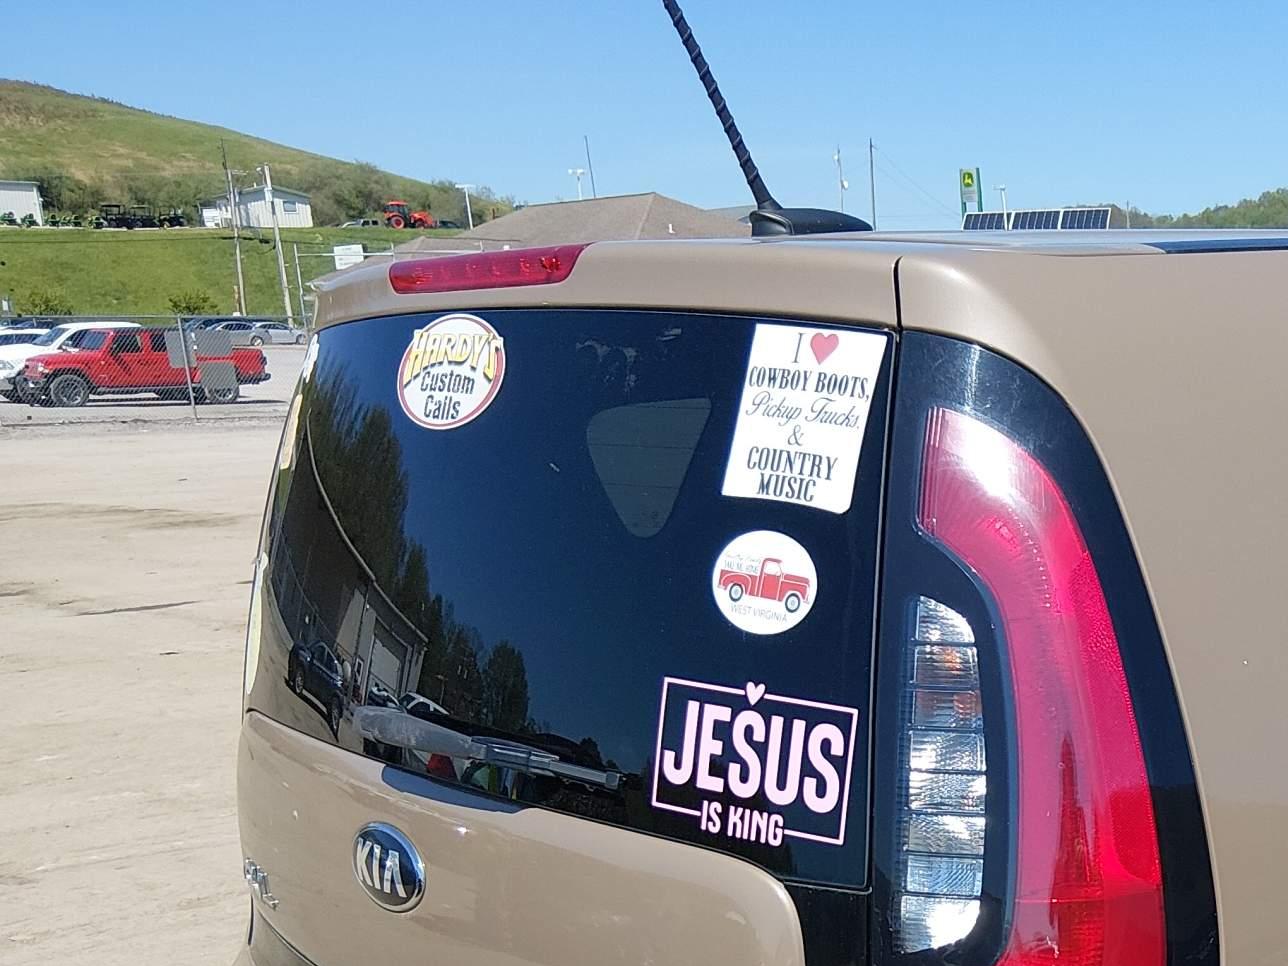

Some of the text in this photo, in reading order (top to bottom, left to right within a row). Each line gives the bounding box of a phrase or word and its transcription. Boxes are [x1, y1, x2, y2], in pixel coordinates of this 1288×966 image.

[403, 331, 502, 388] HARDY'S
[792, 332, 808, 364] I
[420, 370, 475, 394] Custom
[749, 366, 870, 402] COWBOY BOOTS,
[745, 390, 802, 426] Pickup
[787, 424, 804, 446] &
[747, 446, 838, 481] COUNTRY
[756, 473, 816, 502] MUSIC
[730, 603, 788, 623] WEST VIRGINIA
[663, 699, 845, 814] JESUS
[701, 800, 785, 847] IS KING
[355, 837, 408, 898] KIA
